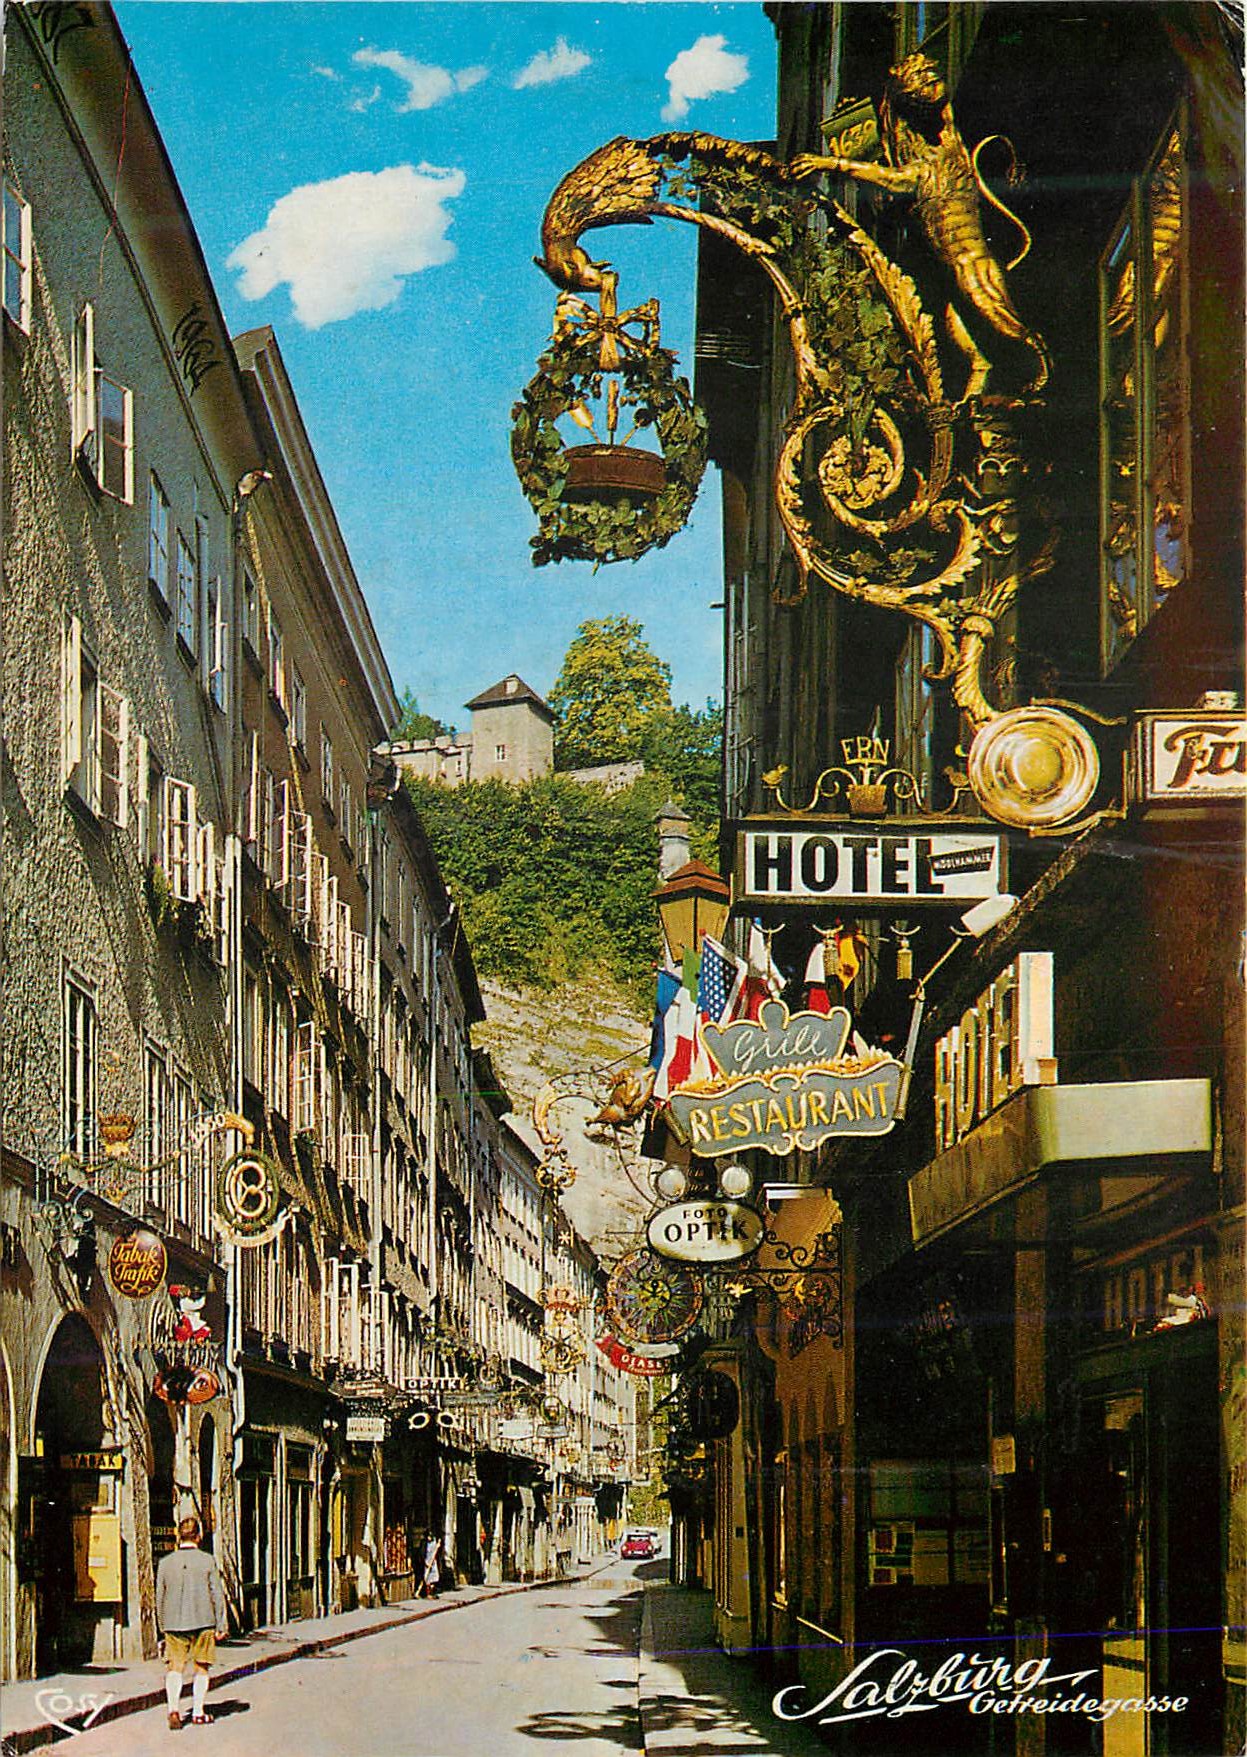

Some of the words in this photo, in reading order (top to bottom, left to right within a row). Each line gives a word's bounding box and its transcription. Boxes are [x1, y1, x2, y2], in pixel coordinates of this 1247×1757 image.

[754, 835, 944, 894] HOTEL
[733, 1025, 828, 1073] Grill
[690, 1082, 890, 1143] RESTAURANT
[683, 1207, 727, 1219] FOTO
[664, 1221, 748, 1242] OPTIK
[112, 1238, 160, 1264] Tabak
[114, 1262, 161, 1291] Trafik
[408, 1379, 457, 1390] OPTIK
[71, 1453, 115, 1469] TABAK
